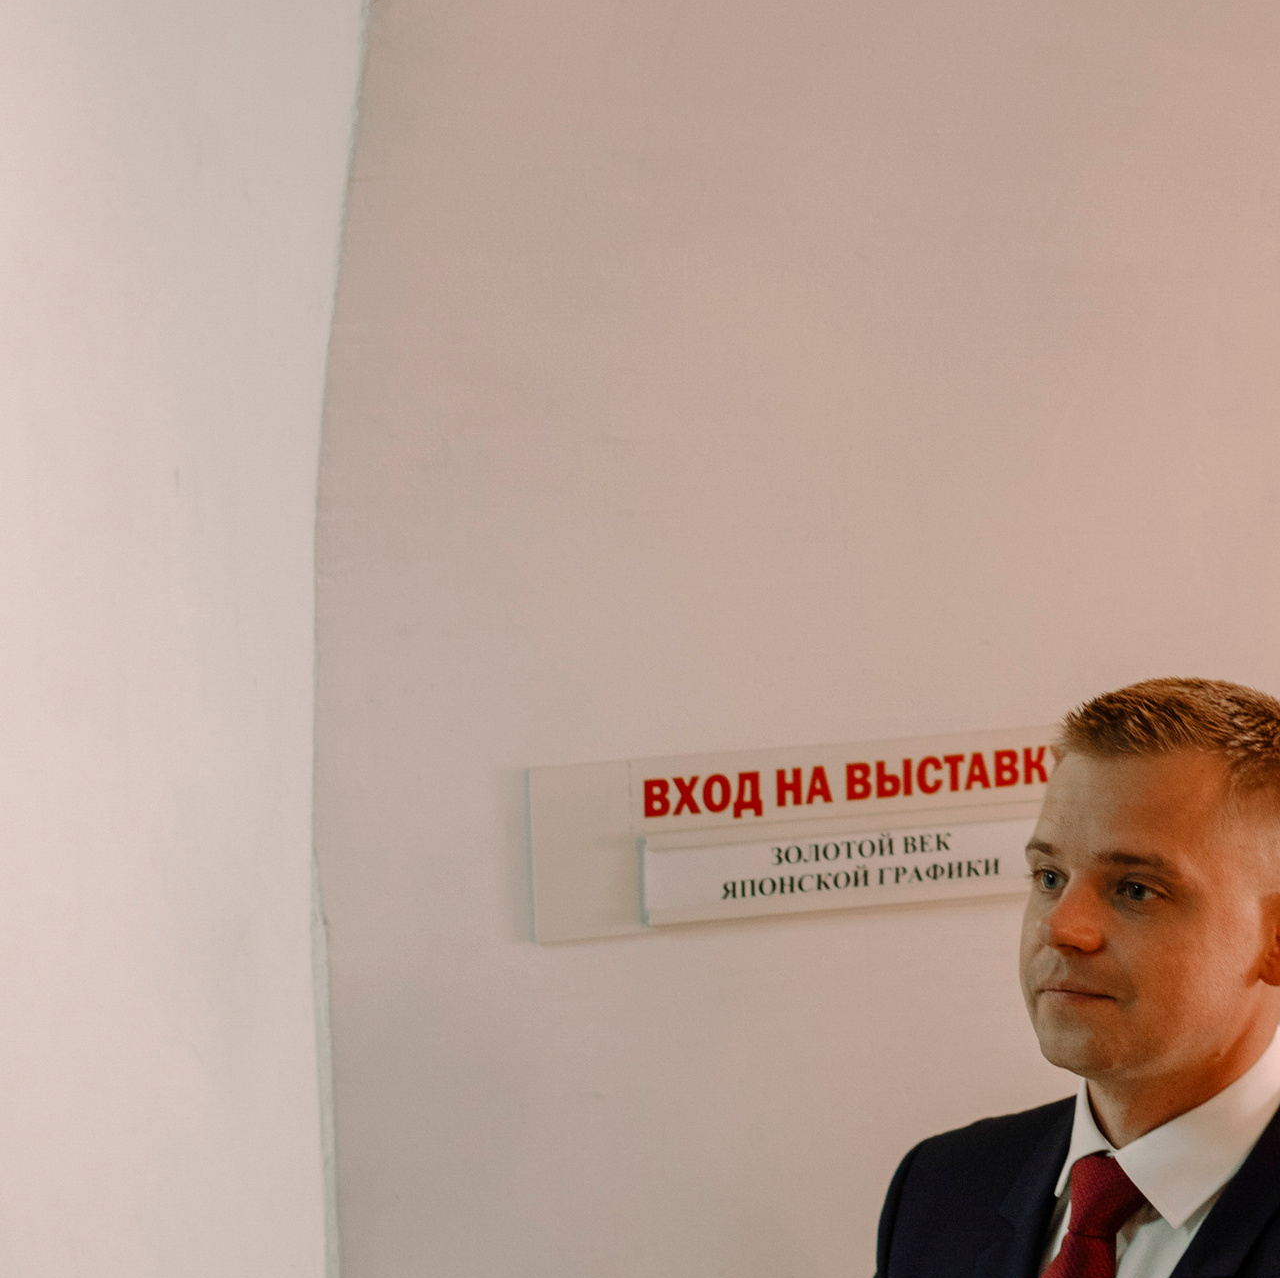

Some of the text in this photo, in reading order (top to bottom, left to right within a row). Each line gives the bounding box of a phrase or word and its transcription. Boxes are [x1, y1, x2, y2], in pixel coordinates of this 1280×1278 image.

[643, 745, 1066, 818] ВХОД НА ВЫСТАВК
[770, 832, 951, 866] ЗОЛОТОЙ ВЕК
[721, 857, 1000, 901] ЯПОНСКОЙ ГРАФИКИ
